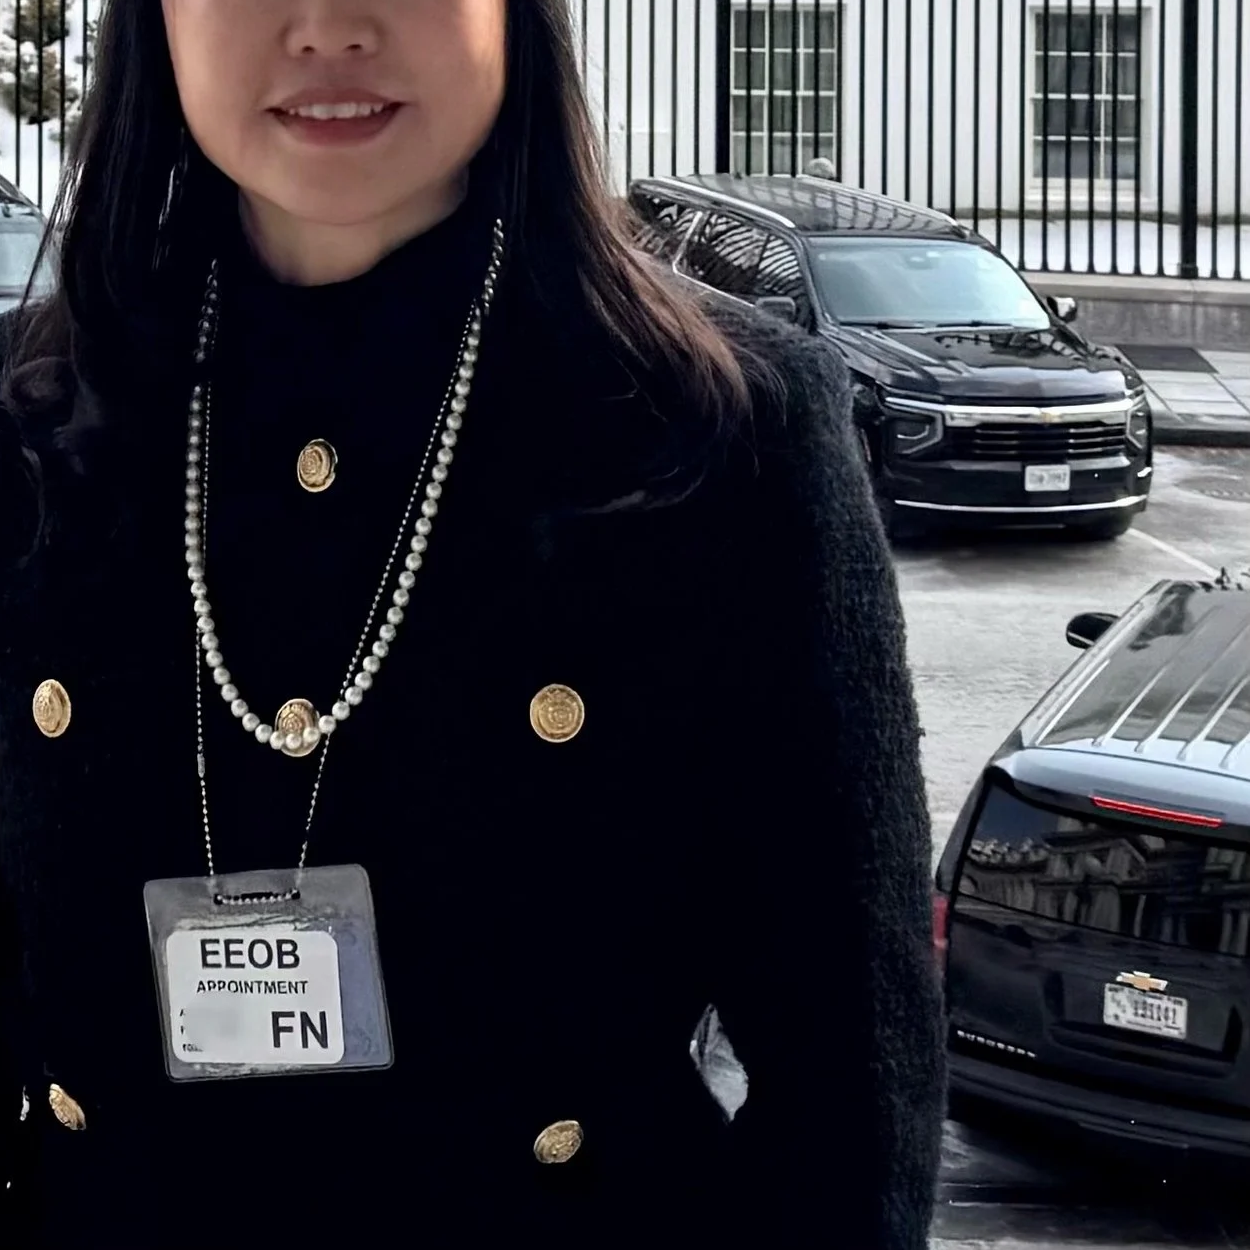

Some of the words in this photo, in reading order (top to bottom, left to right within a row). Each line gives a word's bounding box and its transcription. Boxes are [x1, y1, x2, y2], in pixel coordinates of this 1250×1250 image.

[200, 938, 300, 969] EEOB
[196, 980, 309, 995] APPOINTMENT
[271, 1010, 329, 1049] FN
